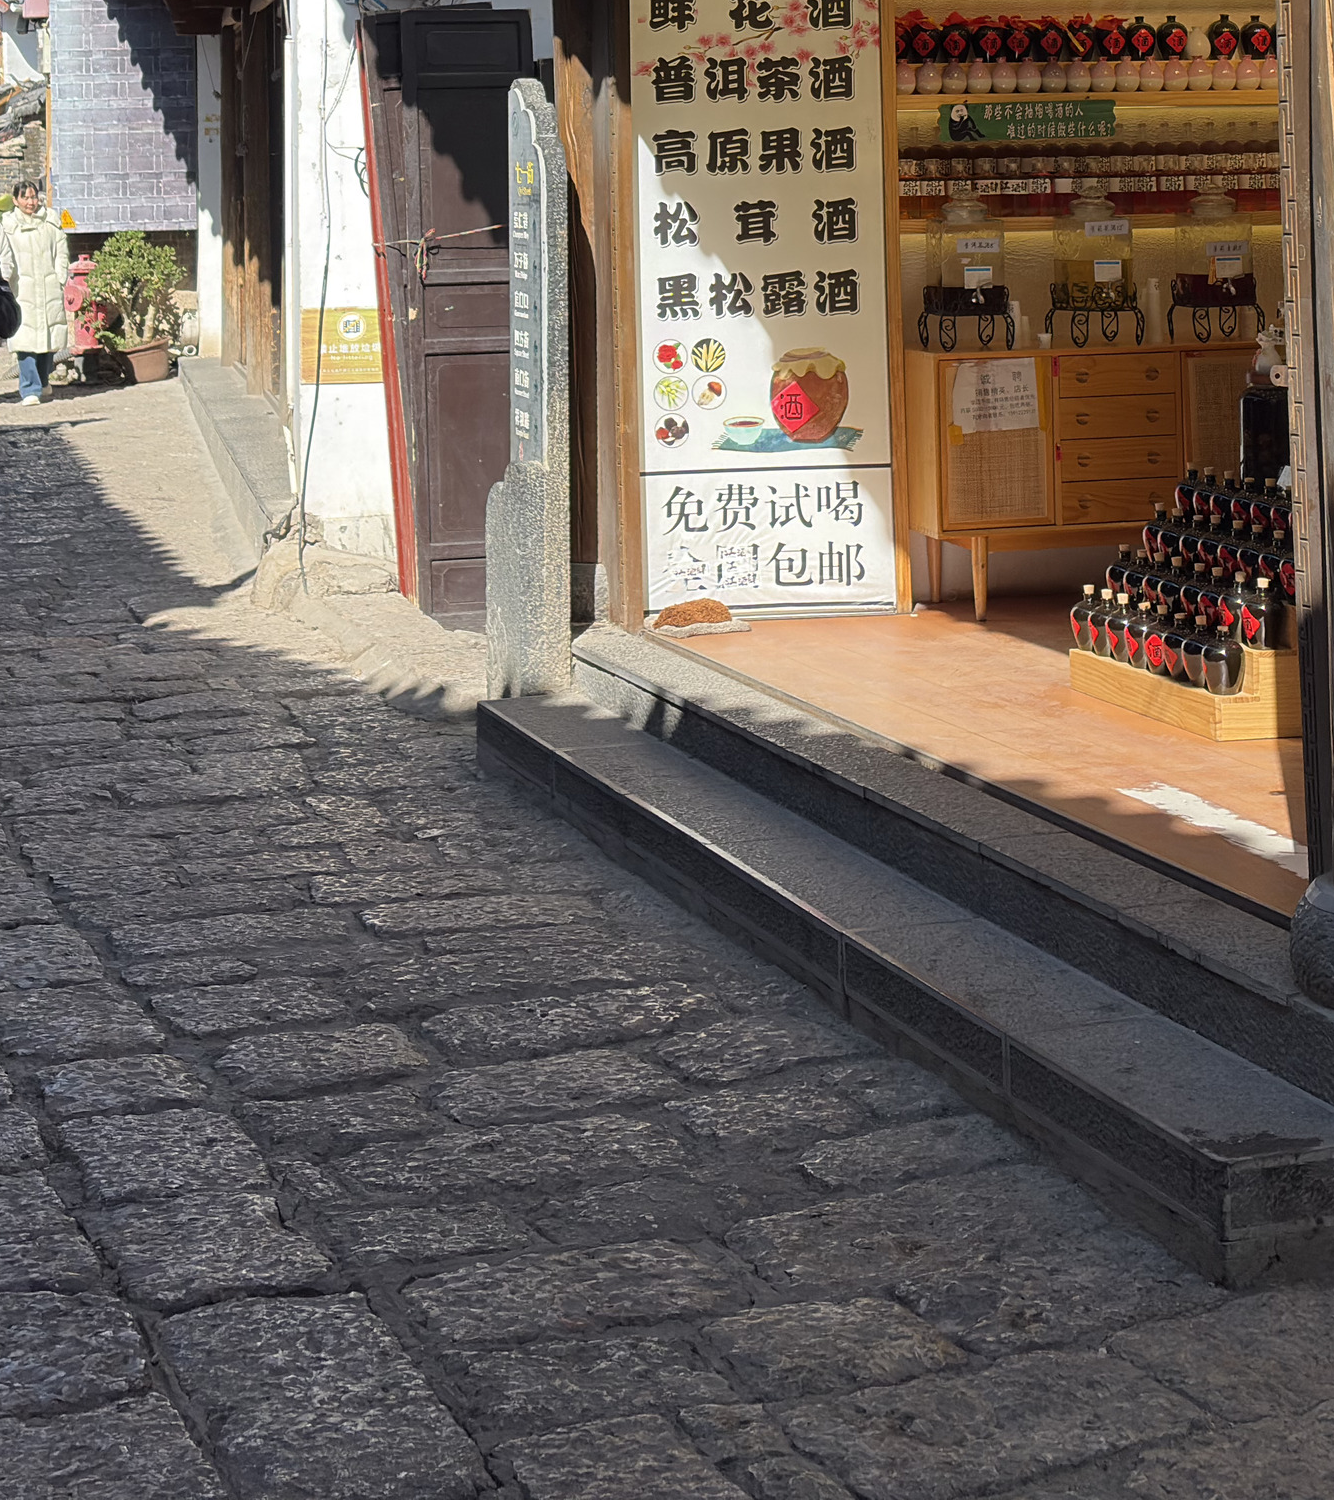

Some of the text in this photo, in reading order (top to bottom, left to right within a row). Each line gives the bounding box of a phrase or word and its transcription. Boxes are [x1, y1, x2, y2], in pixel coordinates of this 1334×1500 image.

[651, 56, 855, 104] 普洱茶酒
[983, 103, 1085, 121] 那些不会抽烟喝酒的人
[651, 126, 856, 175] 高原果酒
[653, 197, 858, 246] 松茸酒
[656, 268, 860, 320] 黑松露酒
[780, 393, 803, 421] 酒
[661, 480, 864, 536] 免费试喝
